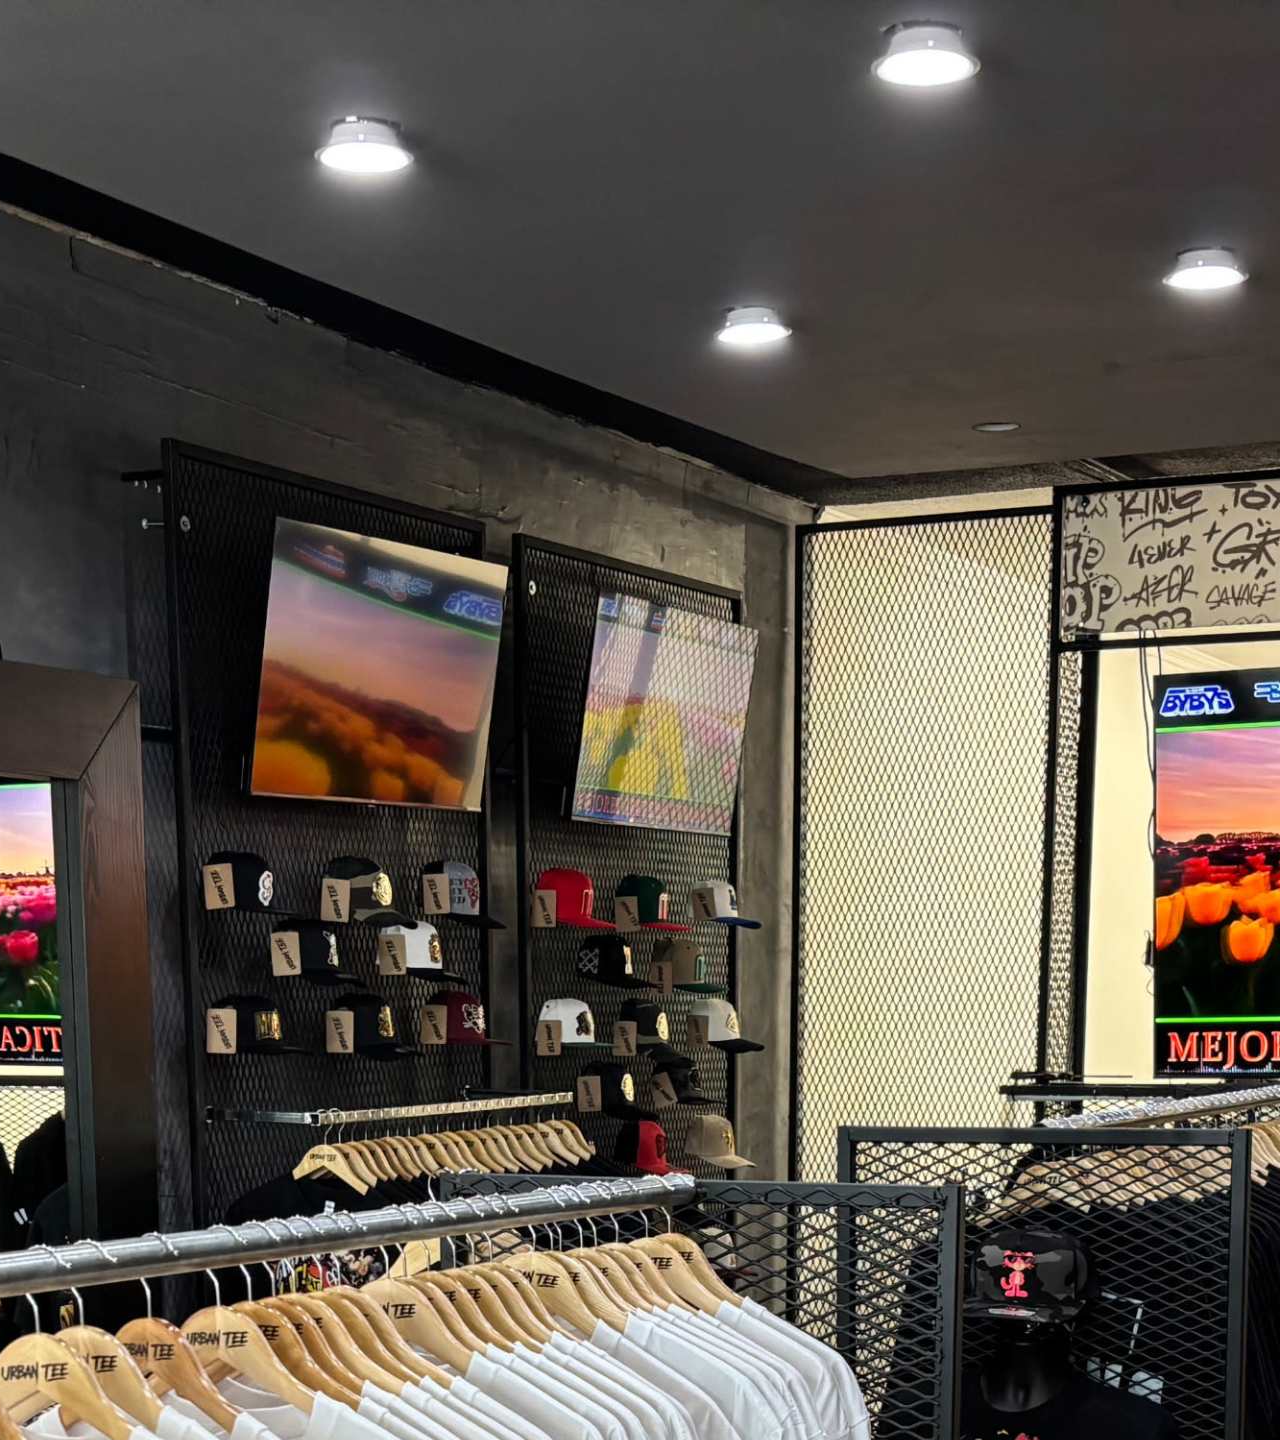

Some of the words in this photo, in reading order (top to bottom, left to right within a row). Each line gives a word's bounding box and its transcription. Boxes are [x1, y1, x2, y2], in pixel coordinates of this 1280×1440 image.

[1205, 581, 1276, 609] SAVAGE
[536, 1273, 561, 1288] TEE
[391, 1303, 416, 1319] TEE
[186, 1330, 221, 1354] URBAN
[222, 1331, 249, 1348] TEE
[151, 1343, 175, 1361] TEE
[0, 1361, 40, 1385] URBAN
[41, 1362, 69, 1381] TEE
[92, 1355, 118, 1373] TEE
